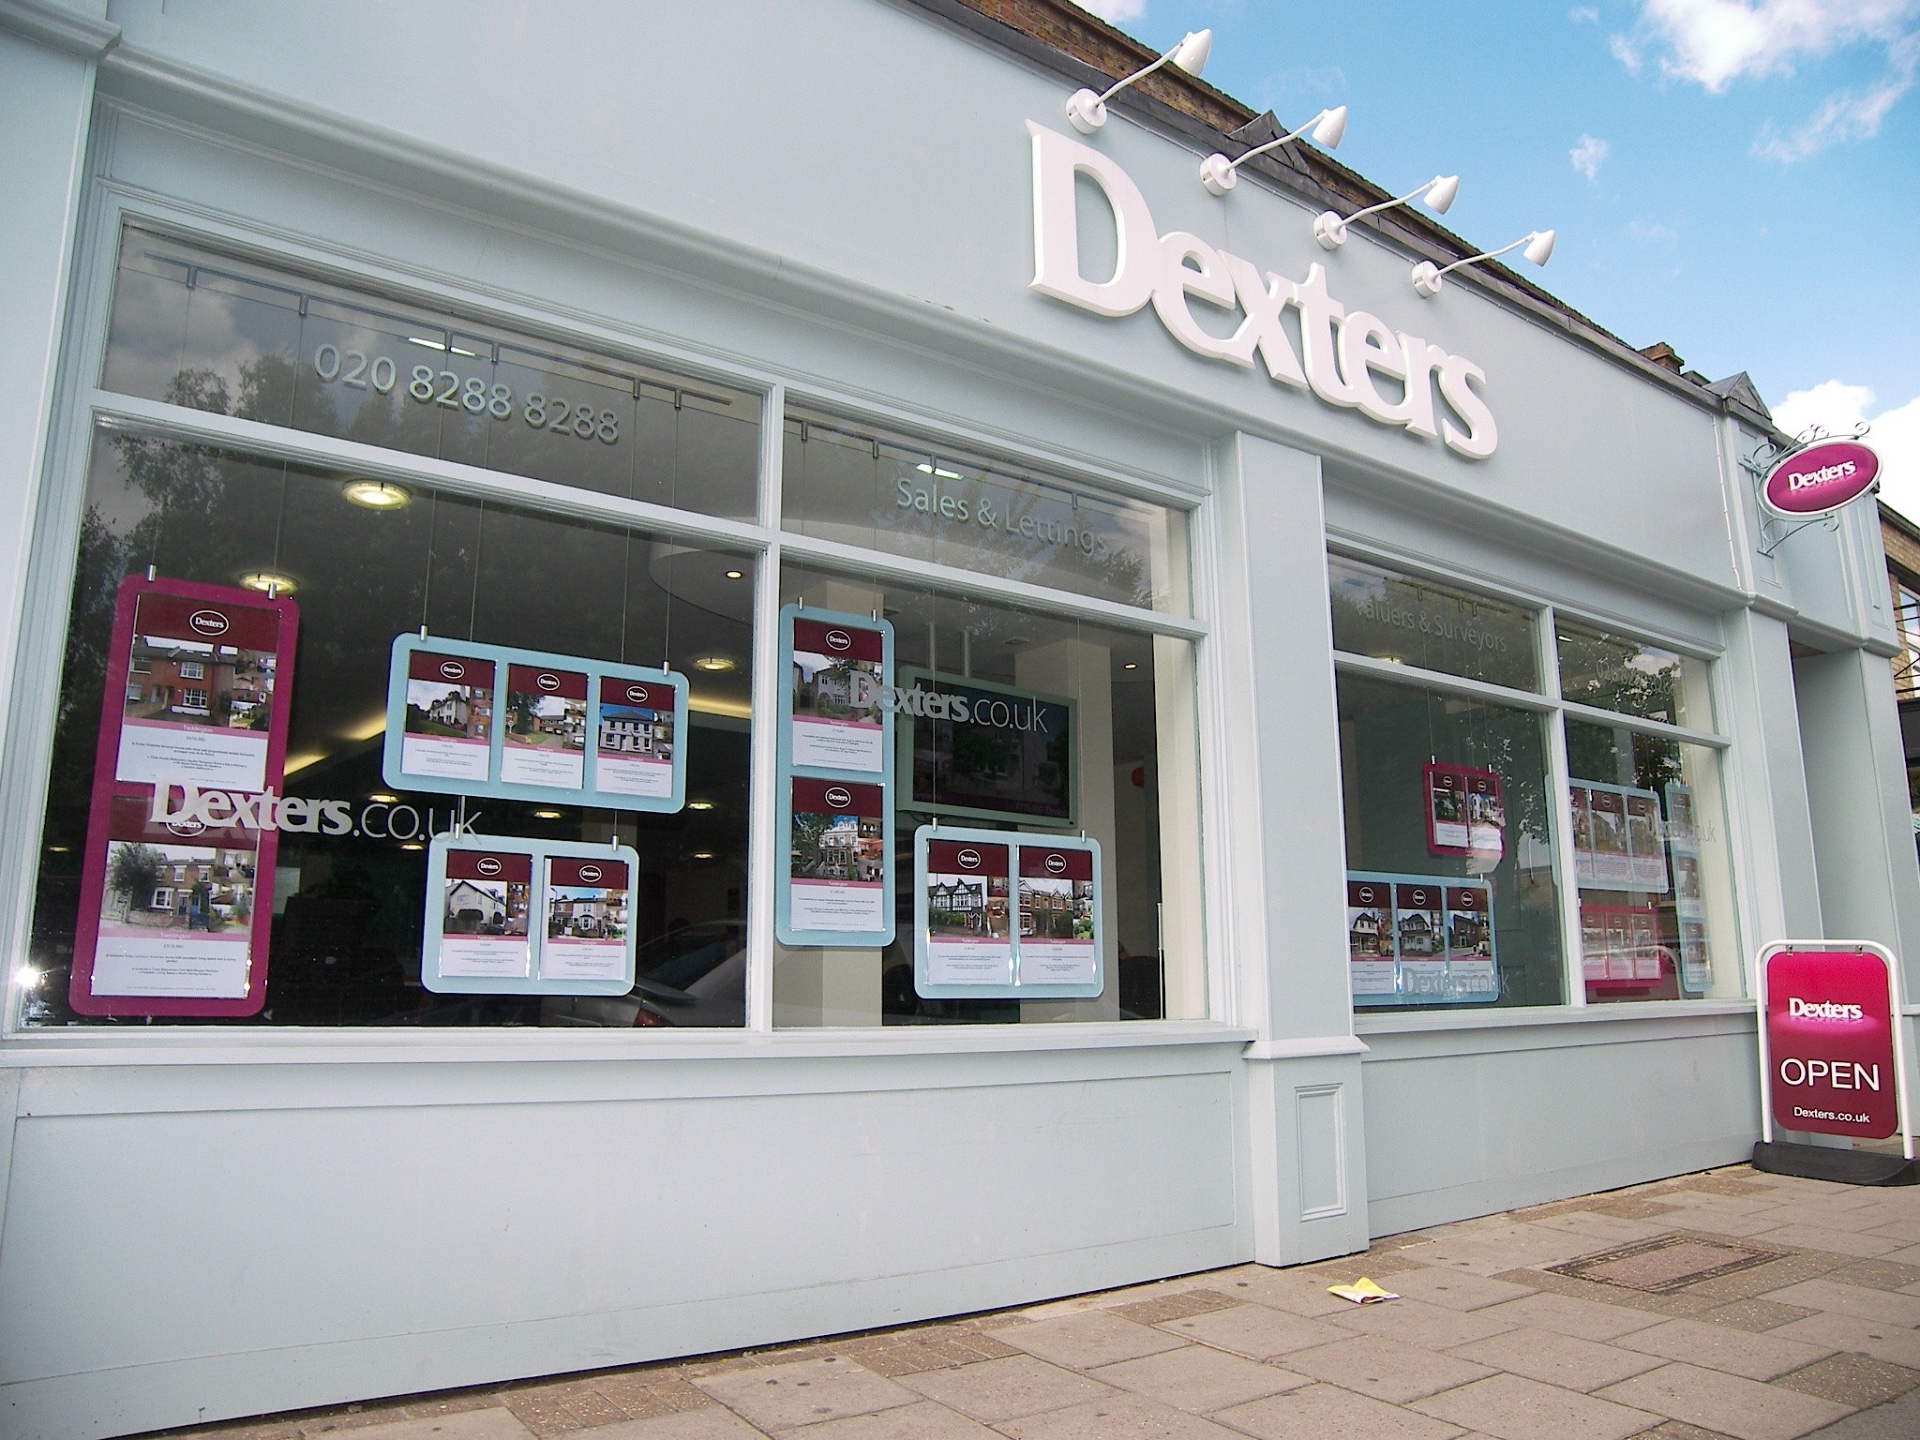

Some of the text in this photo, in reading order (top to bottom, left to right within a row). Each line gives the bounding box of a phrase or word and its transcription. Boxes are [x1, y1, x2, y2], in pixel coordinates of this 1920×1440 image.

[1025, 118, 1499, 460] Dexters
[314, 343, 619, 443] 020 8288 8288
[1788, 460, 1857, 491] Dexters
[896, 477, 1109, 557] Sales & Lettings
[195, 616, 225, 629] Dexters
[1418, 611, 1431, 634] &
[1434, 615, 1508, 653] Surveyors
[850, 669, 1048, 733] Dexters.co.uk
[150, 775, 483, 845] Dexters.co.uk
[1788, 998, 1864, 1019] Dexters
[1780, 1058, 1880, 1091] OPEN
[1793, 1107, 1870, 1123] Dexters.co.uk
